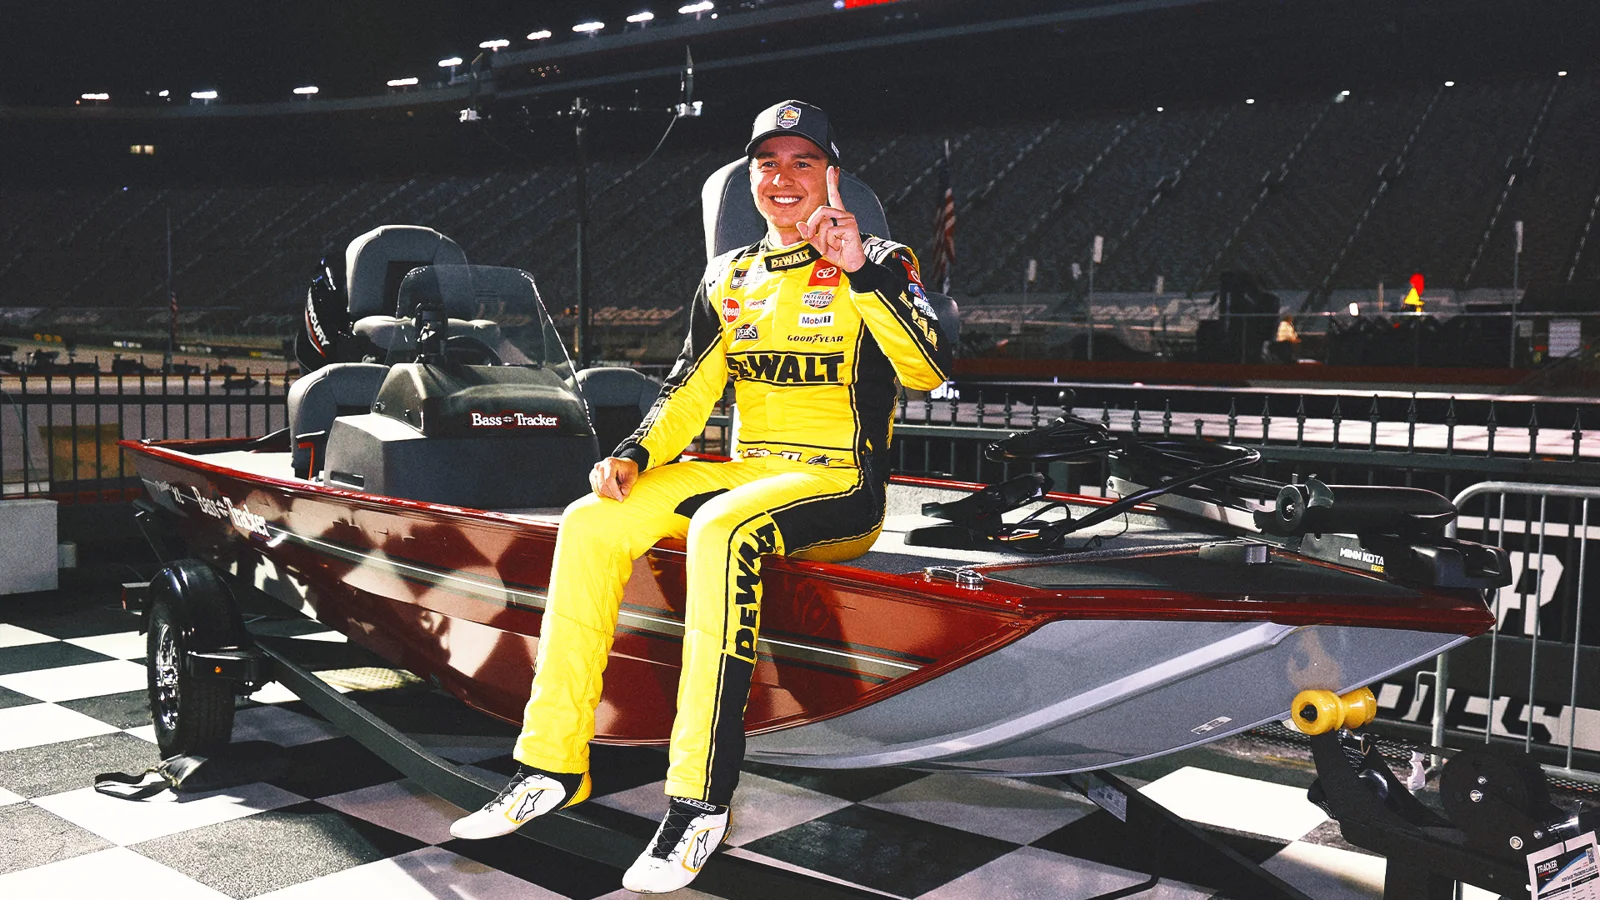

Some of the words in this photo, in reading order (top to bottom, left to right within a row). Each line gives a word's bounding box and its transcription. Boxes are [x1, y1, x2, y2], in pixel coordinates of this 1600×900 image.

[471, 413, 503, 426] Bass
[514, 413, 558, 426] Tracker
[222, 496, 271, 537] Tracker
[1362, 552, 1385, 566] KOTA
